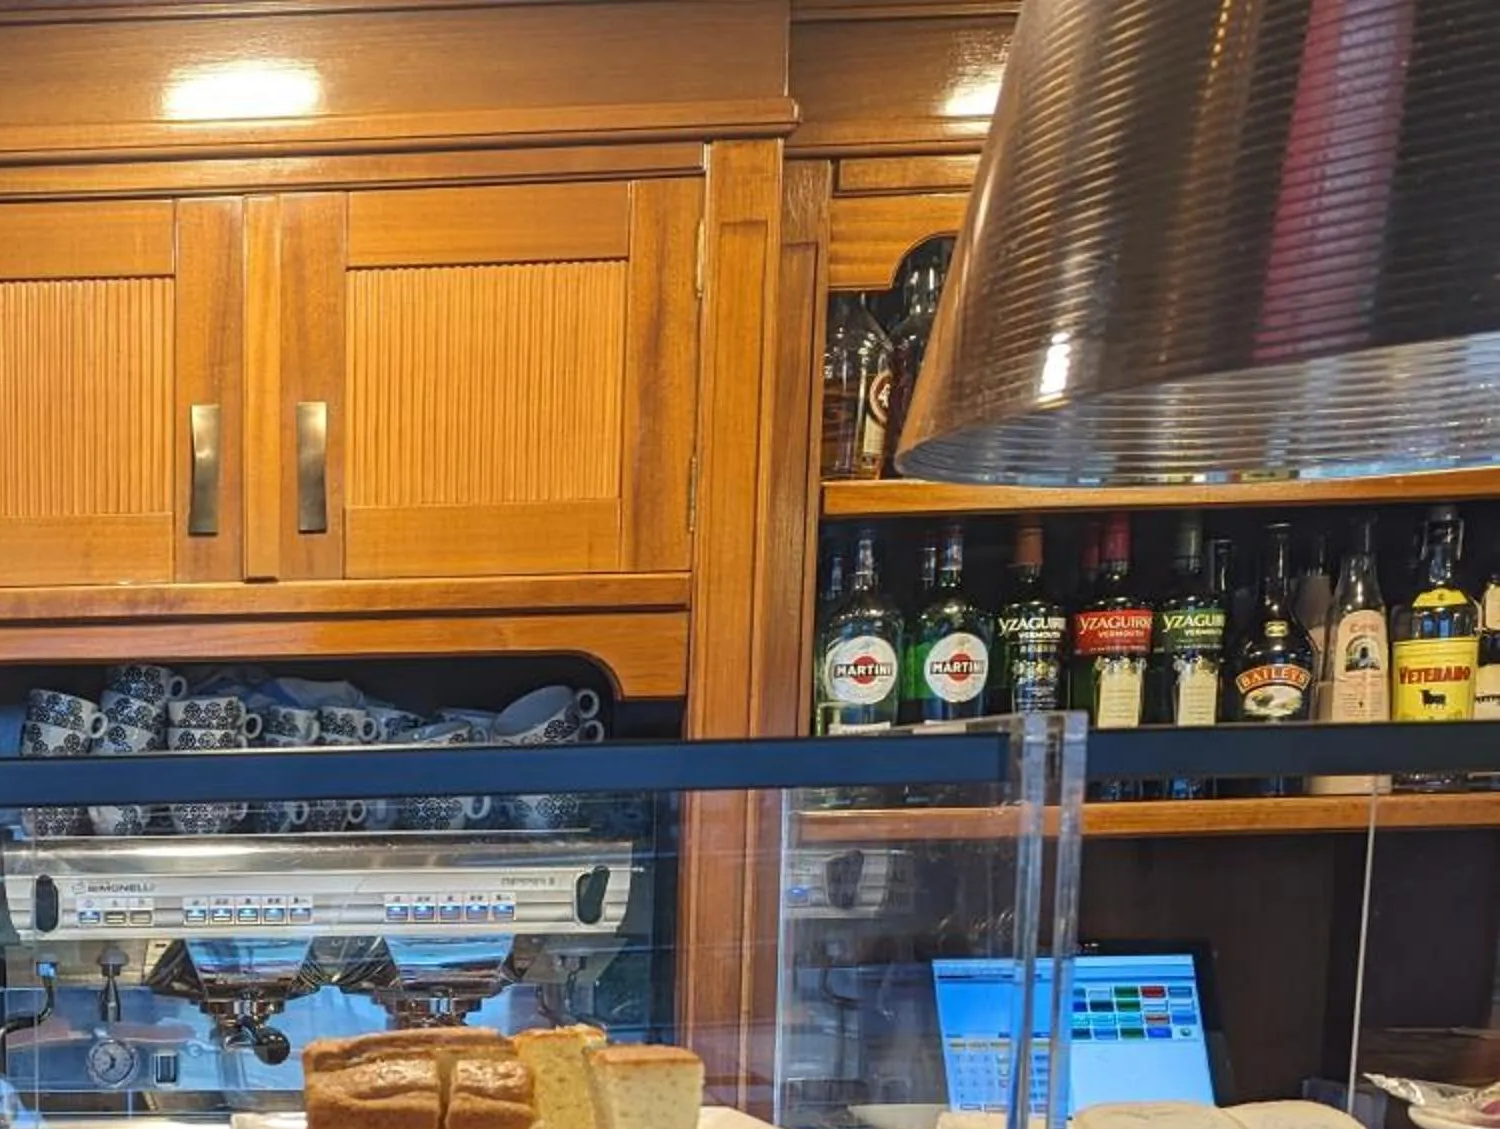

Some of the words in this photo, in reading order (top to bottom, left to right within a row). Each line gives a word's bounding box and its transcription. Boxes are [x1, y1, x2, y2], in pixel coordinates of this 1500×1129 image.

[835, 663, 892, 678] MARTINI
[1241, 665, 1306, 688] BAILEYS
[1400, 665, 1471, 685] VETERANO
